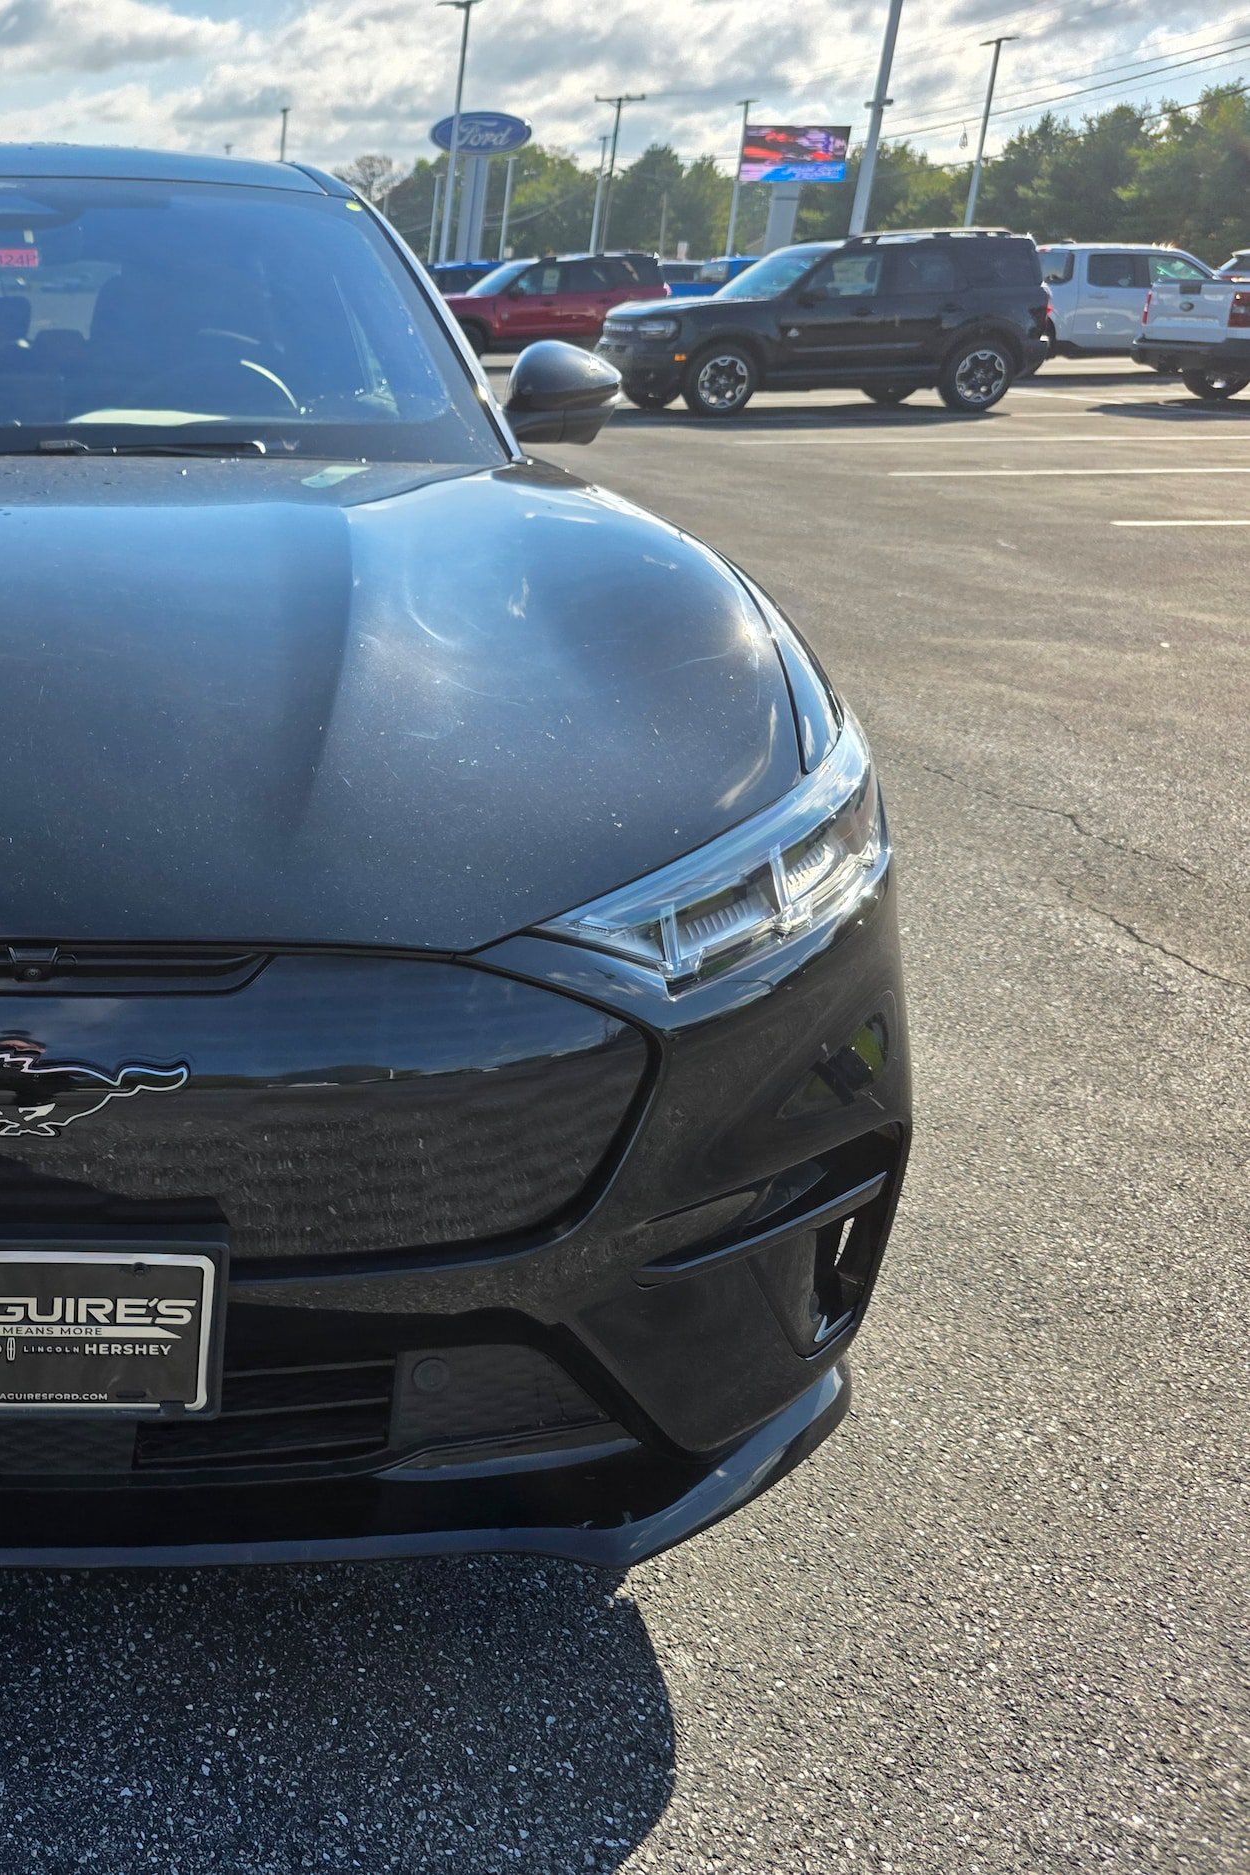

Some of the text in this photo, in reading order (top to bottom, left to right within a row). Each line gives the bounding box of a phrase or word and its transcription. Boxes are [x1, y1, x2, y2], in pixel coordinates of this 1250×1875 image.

[454, 120, 513, 146] Ford
[2, 1326, 103, 1336] MEANS MORE
[23, 1343, 172, 1356] LINCOLN HERSHEY
